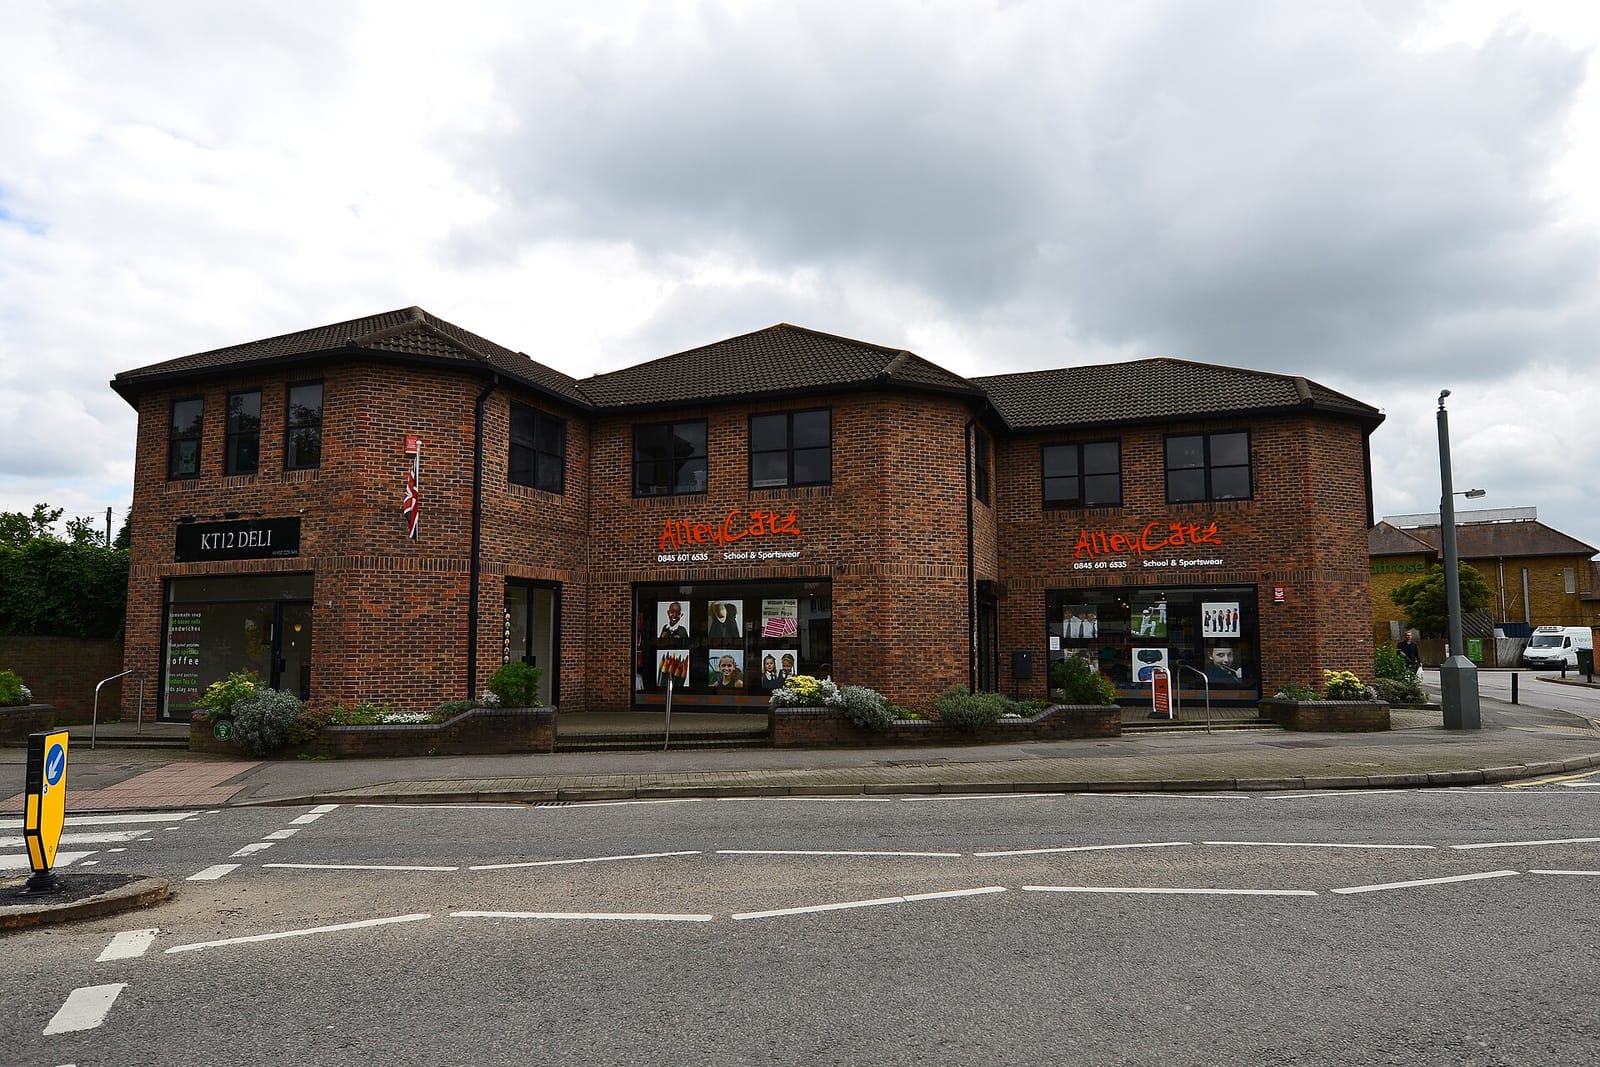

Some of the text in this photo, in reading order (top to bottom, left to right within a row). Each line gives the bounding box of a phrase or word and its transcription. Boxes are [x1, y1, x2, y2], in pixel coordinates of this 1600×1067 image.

[201, 530, 273, 550] KT12 DELI
[657, 554, 676, 562] 0845
[723, 551, 801, 560] School & Sportswear
[1073, 562, 1092, 570] 0845
[1143, 558, 1224, 568] School & Sportswear
[1370, 561, 1425, 573] aitrose
[167, 656, 200, 665] coffee
